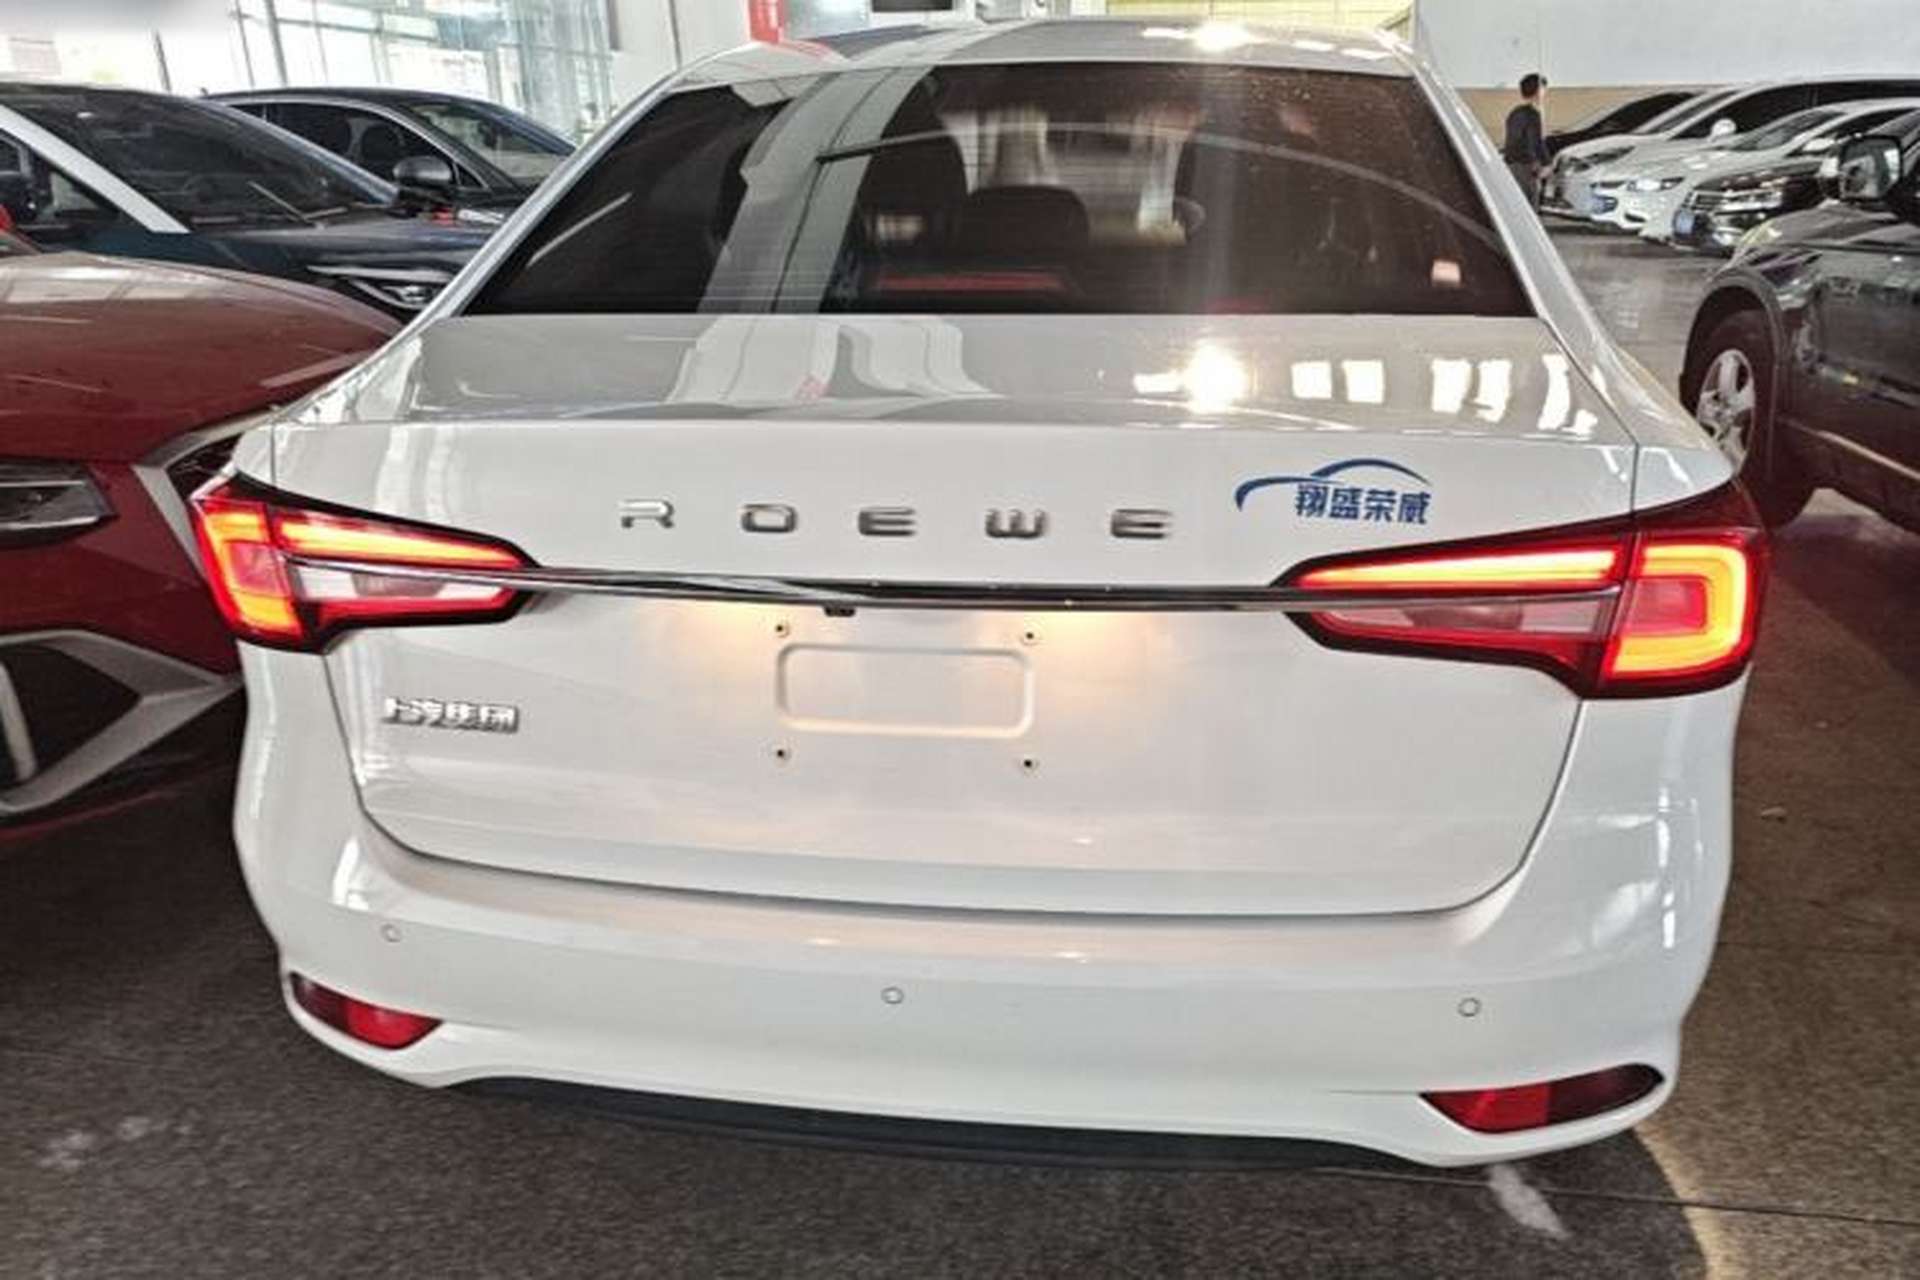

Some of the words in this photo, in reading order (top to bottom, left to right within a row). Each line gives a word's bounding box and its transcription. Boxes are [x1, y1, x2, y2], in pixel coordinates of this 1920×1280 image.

[619, 499, 1173, 539] ROEWE
[1295, 484, 1431, 524] 翔盛荣威
